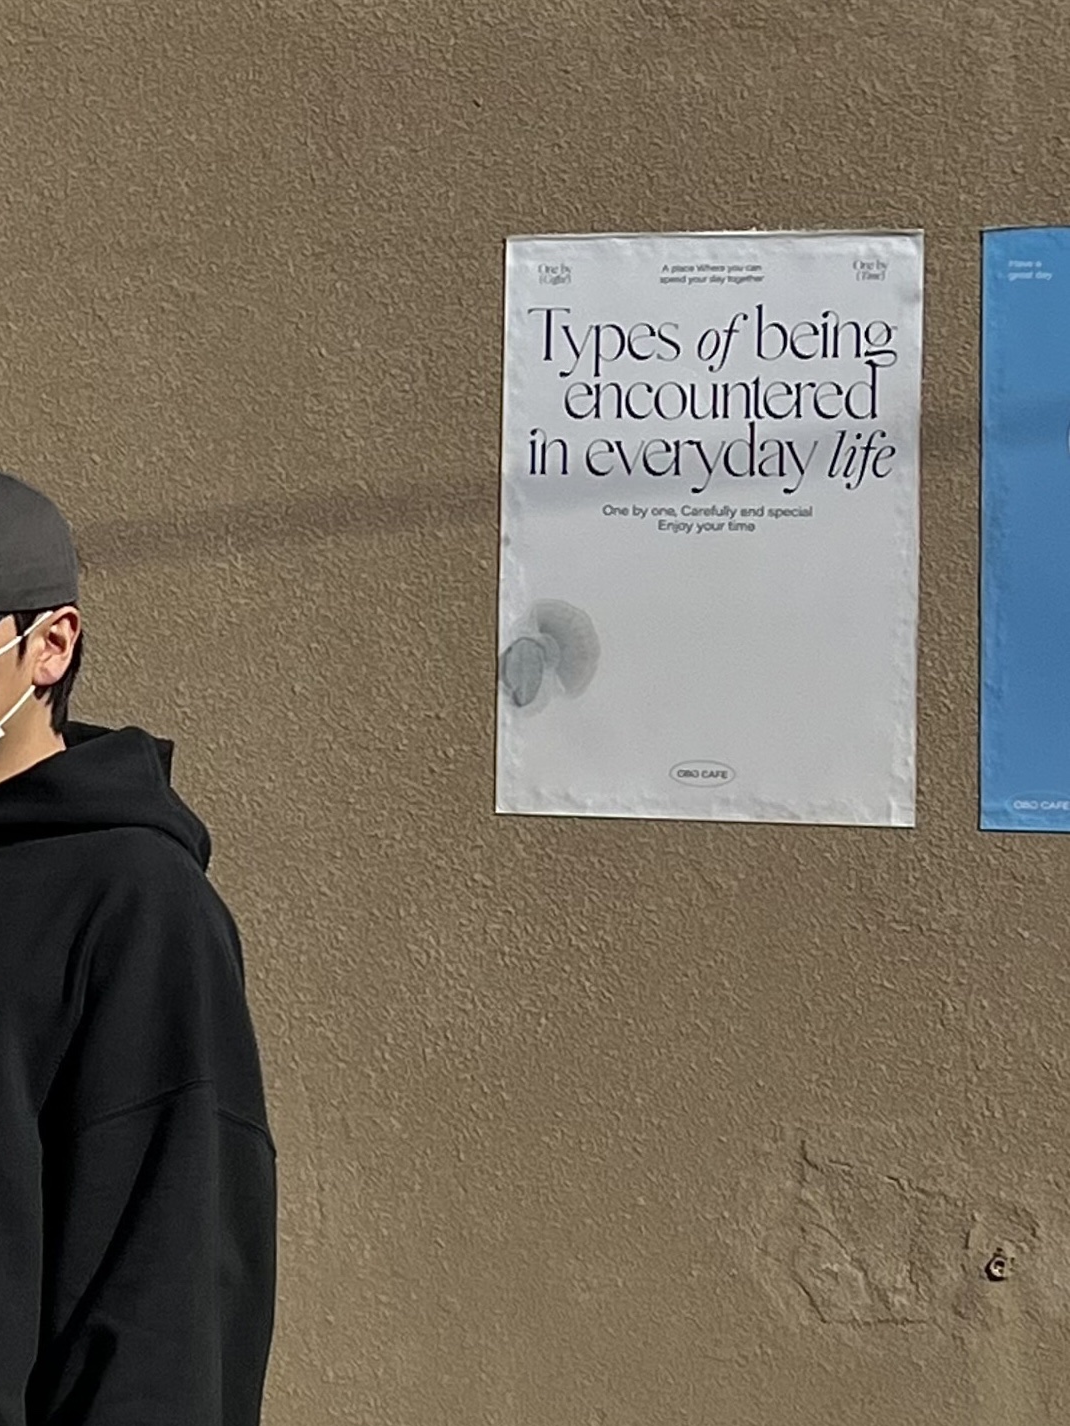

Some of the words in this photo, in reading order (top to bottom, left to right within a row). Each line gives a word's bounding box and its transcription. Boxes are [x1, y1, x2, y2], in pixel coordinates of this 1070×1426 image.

[727, 265, 743, 274] you
[688, 276, 708, 286] your
[727, 275, 765, 285] together
[528, 307, 681, 378] Types
[696, 312, 749, 373] of
[755, 304, 898, 368] being
[564, 361, 878, 421] encountered
[528, 427, 569, 476] in
[585, 421, 819, 494] everyday
[828, 429, 896, 491] life
[602, 504, 629, 516] One
[632, 504, 649, 519] by
[680, 504, 736, 519] Carefully
[740, 505, 765, 517] and
[767, 505, 814, 519] special
[658, 519, 694, 534] Enjoy
[696, 522, 725, 534] your
[728, 520, 756, 532] time
[701, 769, 729, 780] CAFE
